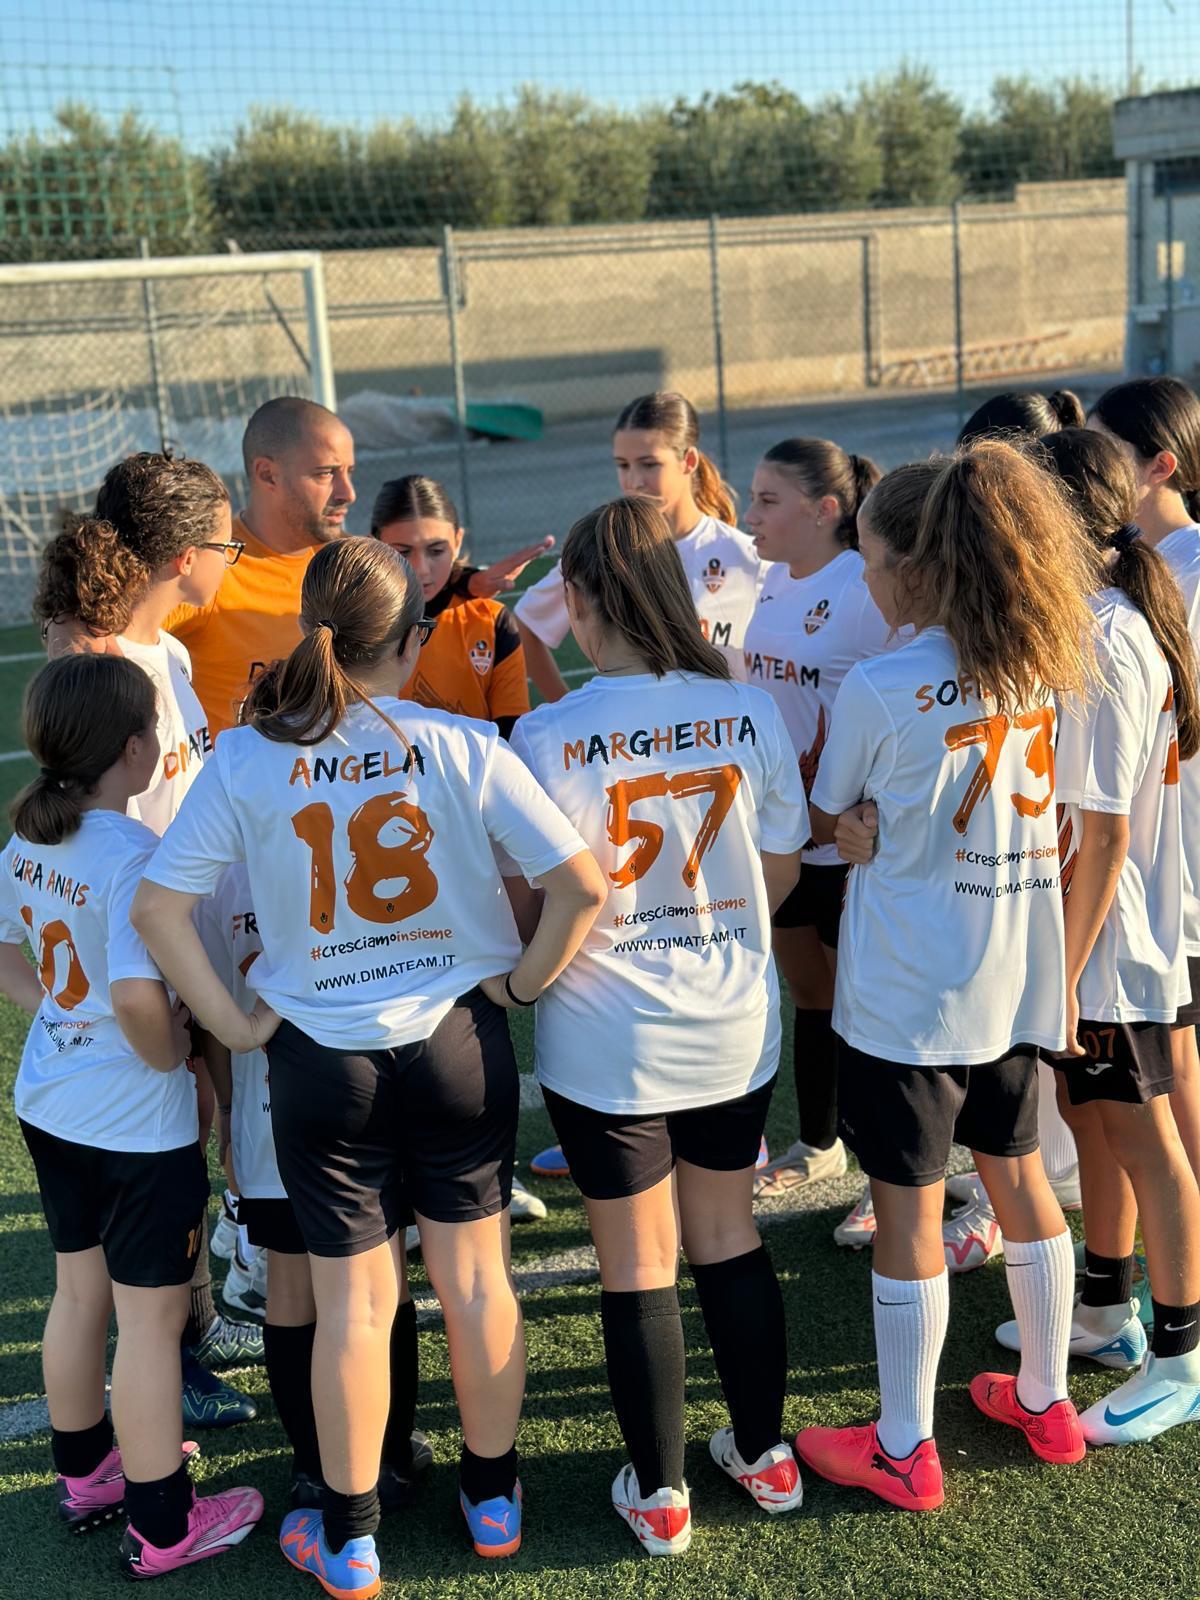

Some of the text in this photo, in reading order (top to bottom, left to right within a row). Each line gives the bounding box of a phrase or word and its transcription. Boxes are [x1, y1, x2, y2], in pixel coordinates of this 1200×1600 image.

[743, 651, 820, 690] MATEAM
[563, 715, 756, 770] MARGHERITA
[288, 744, 426, 789] ANGELA
[944, 707, 1057, 834] 73
[605, 763, 743, 891] 57
[12, 853, 90, 907] URA ANAIS
[291, 791, 439, 935] 18
[613, 897, 747, 928] #cresciamoinsieme
[310, 927, 453, 961] #cresciamoinsieme
[613, 927, 747, 954] WWW.DIMATEAM.IT
[314, 954, 456, 992] WWW.DIMATEAM.IT
[1083, 1028, 1116, 1059] 07
